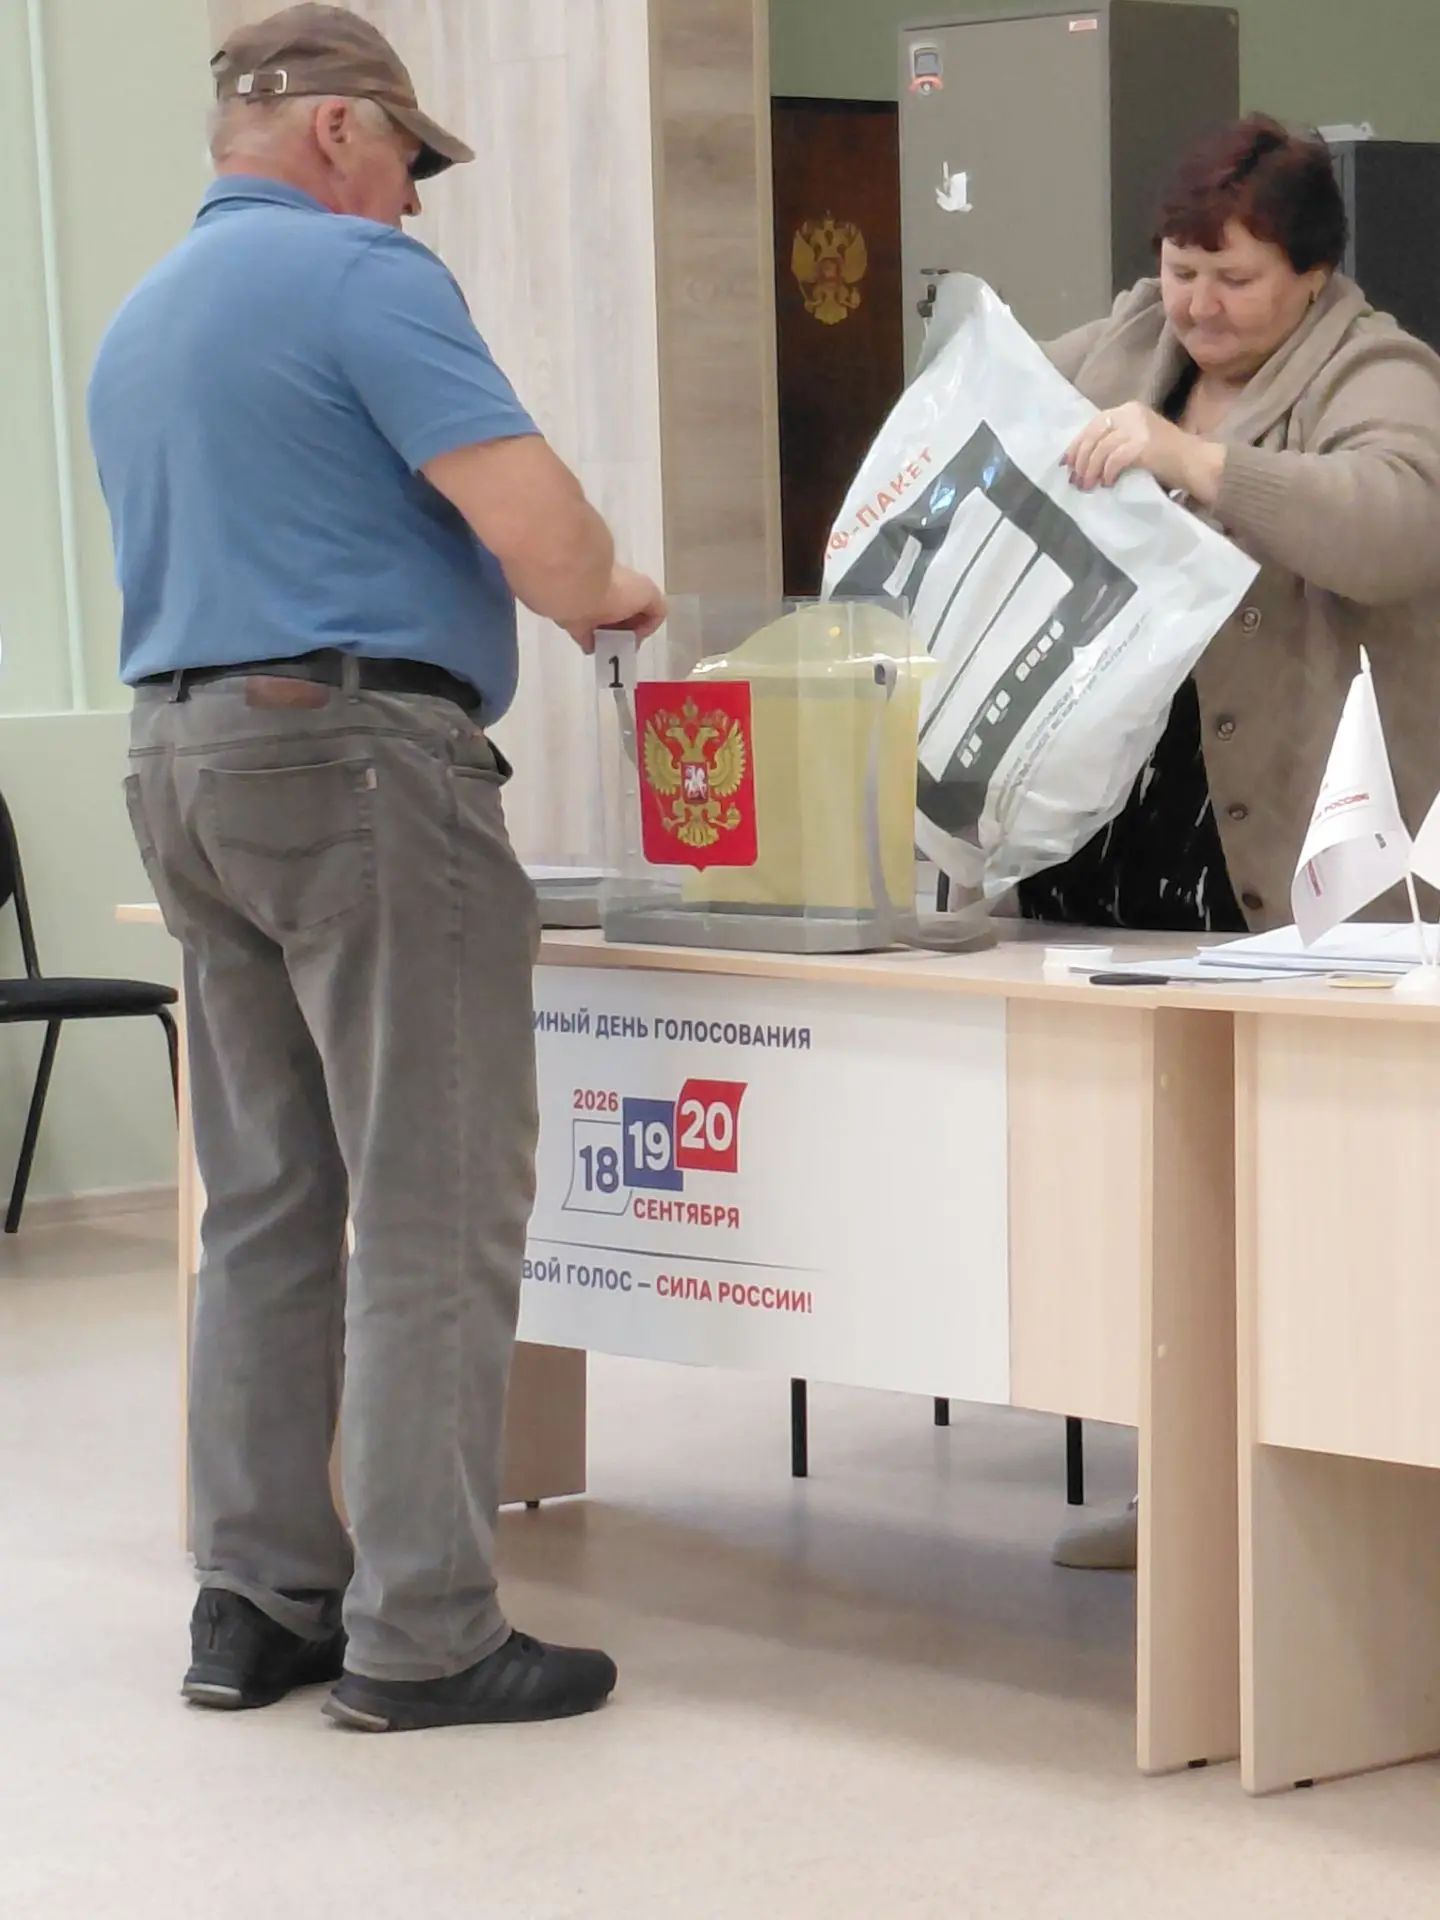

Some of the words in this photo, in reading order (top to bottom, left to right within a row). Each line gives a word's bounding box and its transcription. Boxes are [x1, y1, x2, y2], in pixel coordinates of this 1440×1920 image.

[826, 446, 932, 560] Ф-ПАКЕТ
[608, 655, 624, 688] 1
[595, 1014, 649, 1040] ДЕНЬ
[654, 1017, 811, 1050] ГОЛОСОВАНИЯ
[573, 1088, 619, 1112] 2026
[579, 1145, 619, 1194] 18
[628, 1120, 671, 1171] 19
[680, 1099, 733, 1152] 20
[633, 1198, 740, 1229] СЕНТЯБРЯ
[566, 1264, 632, 1292] ГОЛОС
[656, 1274, 713, 1301] СИЛА
[718, 1281, 813, 1314] РОССИИ!
